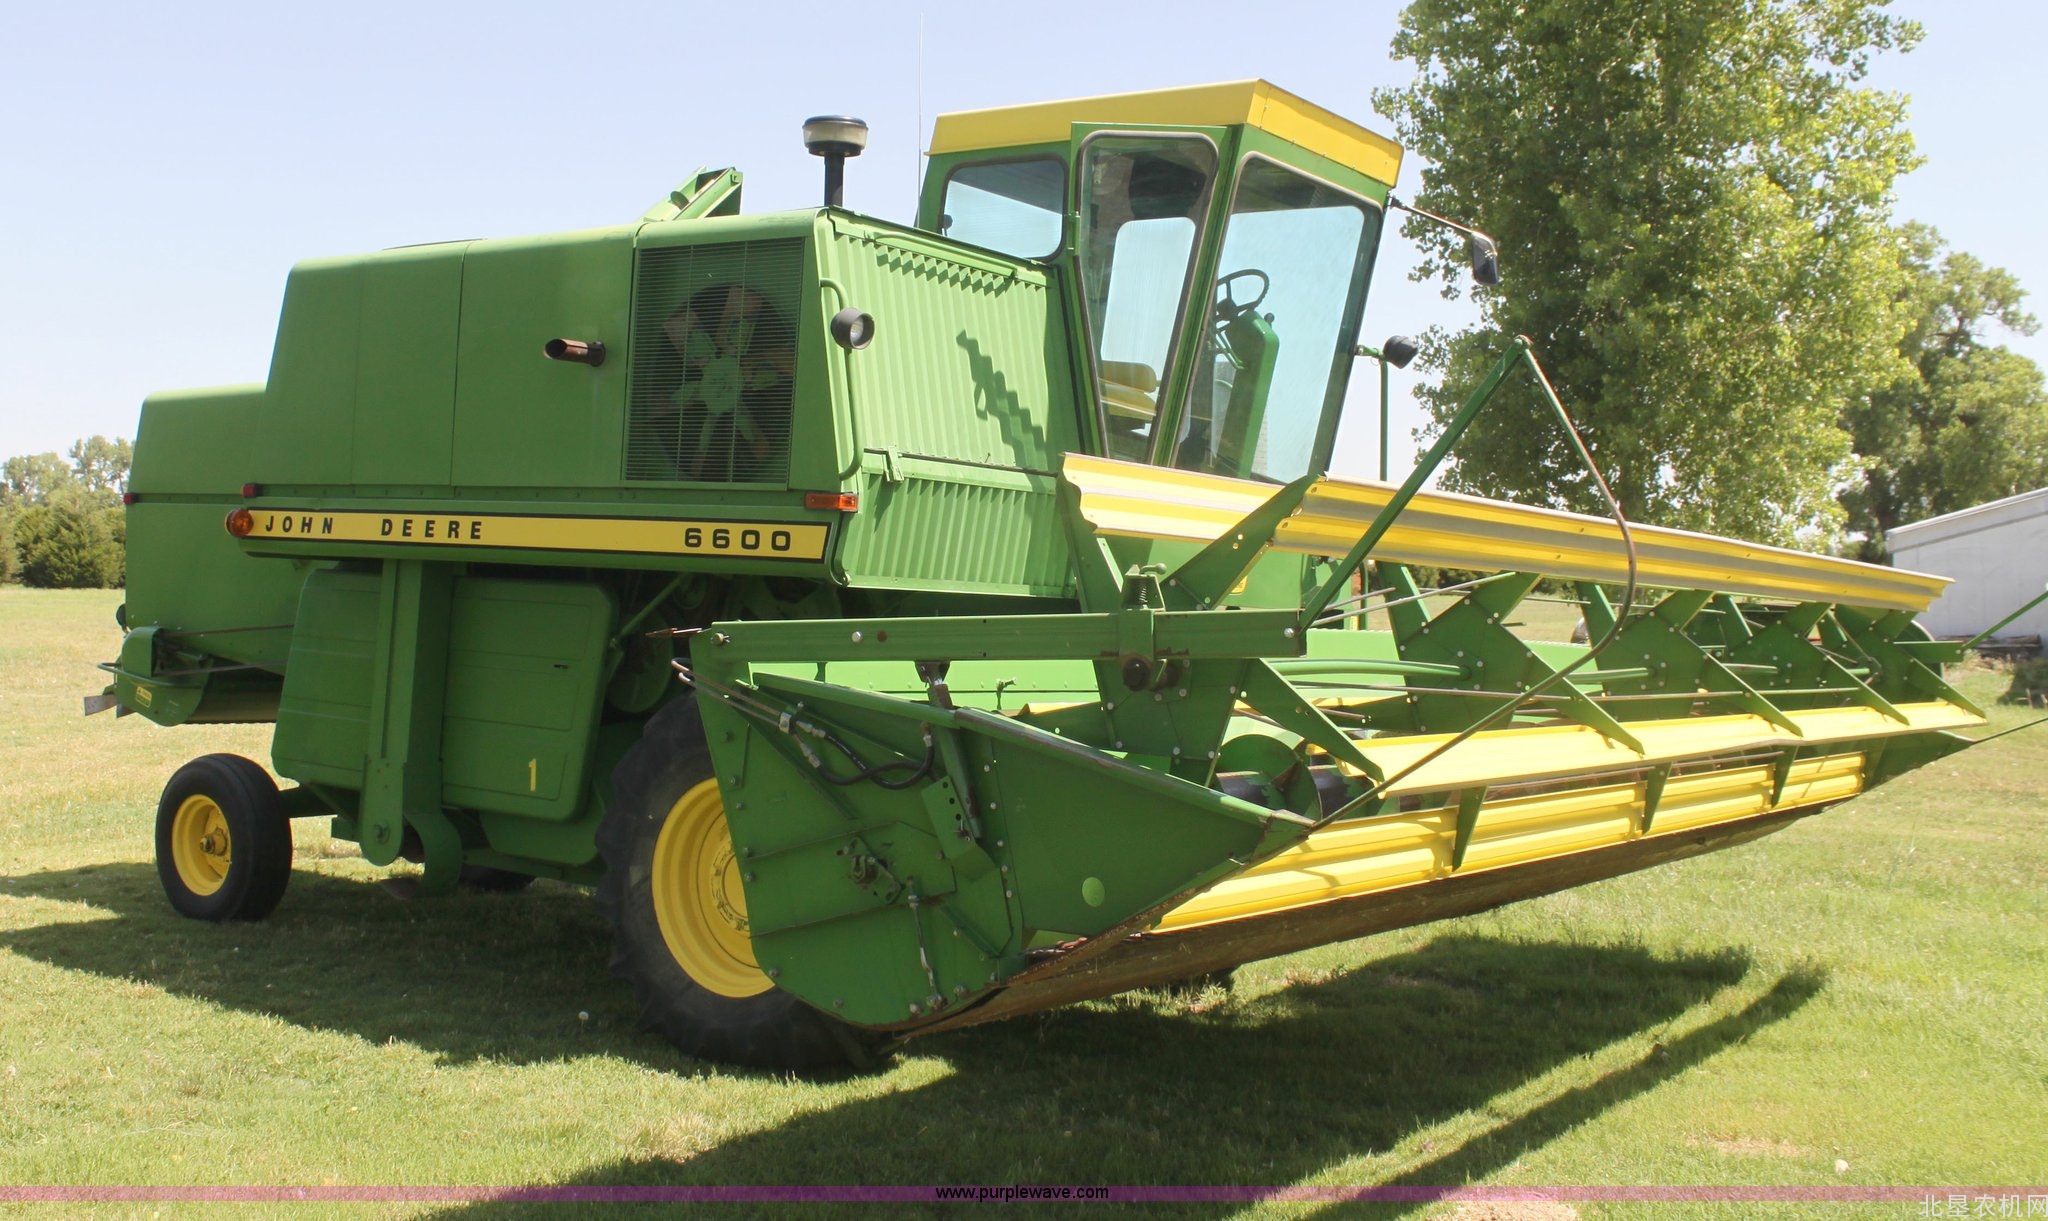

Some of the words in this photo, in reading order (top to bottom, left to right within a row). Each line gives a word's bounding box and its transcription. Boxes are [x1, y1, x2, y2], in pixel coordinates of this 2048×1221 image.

[265, 515, 333, 534] JOHN
[381, 518, 482, 540] DEERE
[684, 527, 791, 552] 6600
[528, 758, 537, 792] 1
